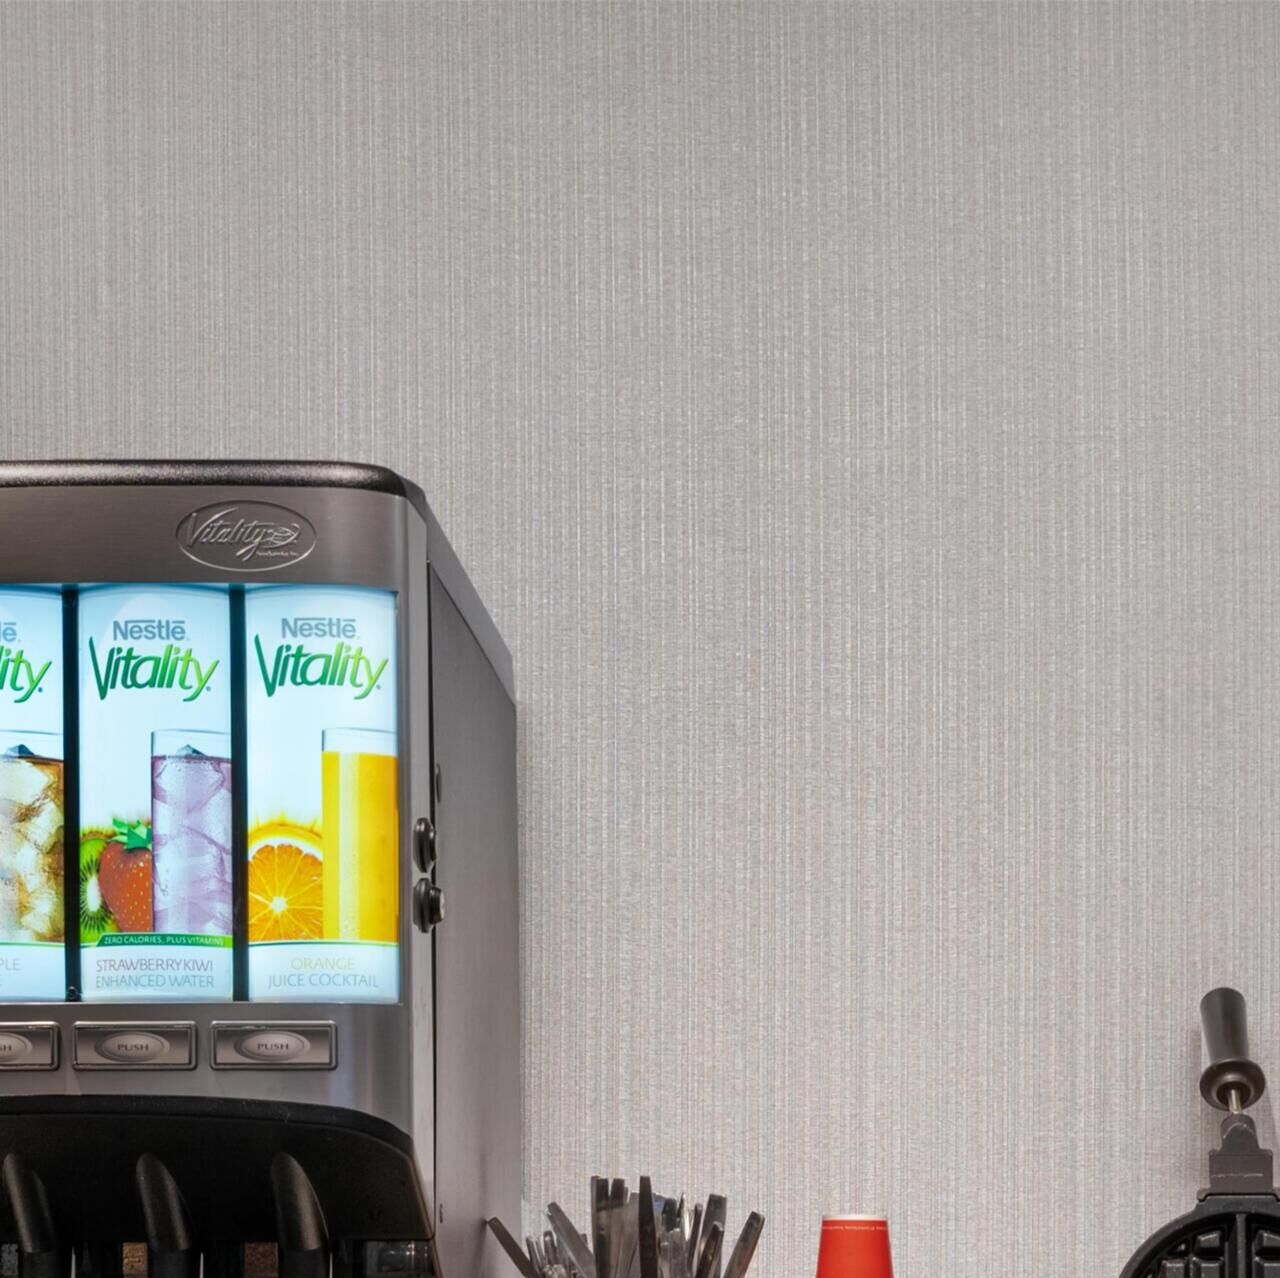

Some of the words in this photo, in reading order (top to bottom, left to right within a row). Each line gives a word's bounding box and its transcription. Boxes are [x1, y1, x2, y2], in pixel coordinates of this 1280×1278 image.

[187, 507, 282, 561] Vitality
[89, 636, 220, 702] Vitality
[254, 633, 389, 700] Vitality
[104, 936, 123, 945] ZERO
[167, 935, 186, 945] PLUS
[290, 956, 356, 971] ORANGE
[95, 974, 166, 989] ENHANCED
[168, 974, 215, 988] WATER
[268, 973, 306, 990] JUICE
[308, 973, 380, 988] COCKTAIL
[116, 1043, 149, 1052] PUSH
[256, 1042, 290, 1051] PUSH
